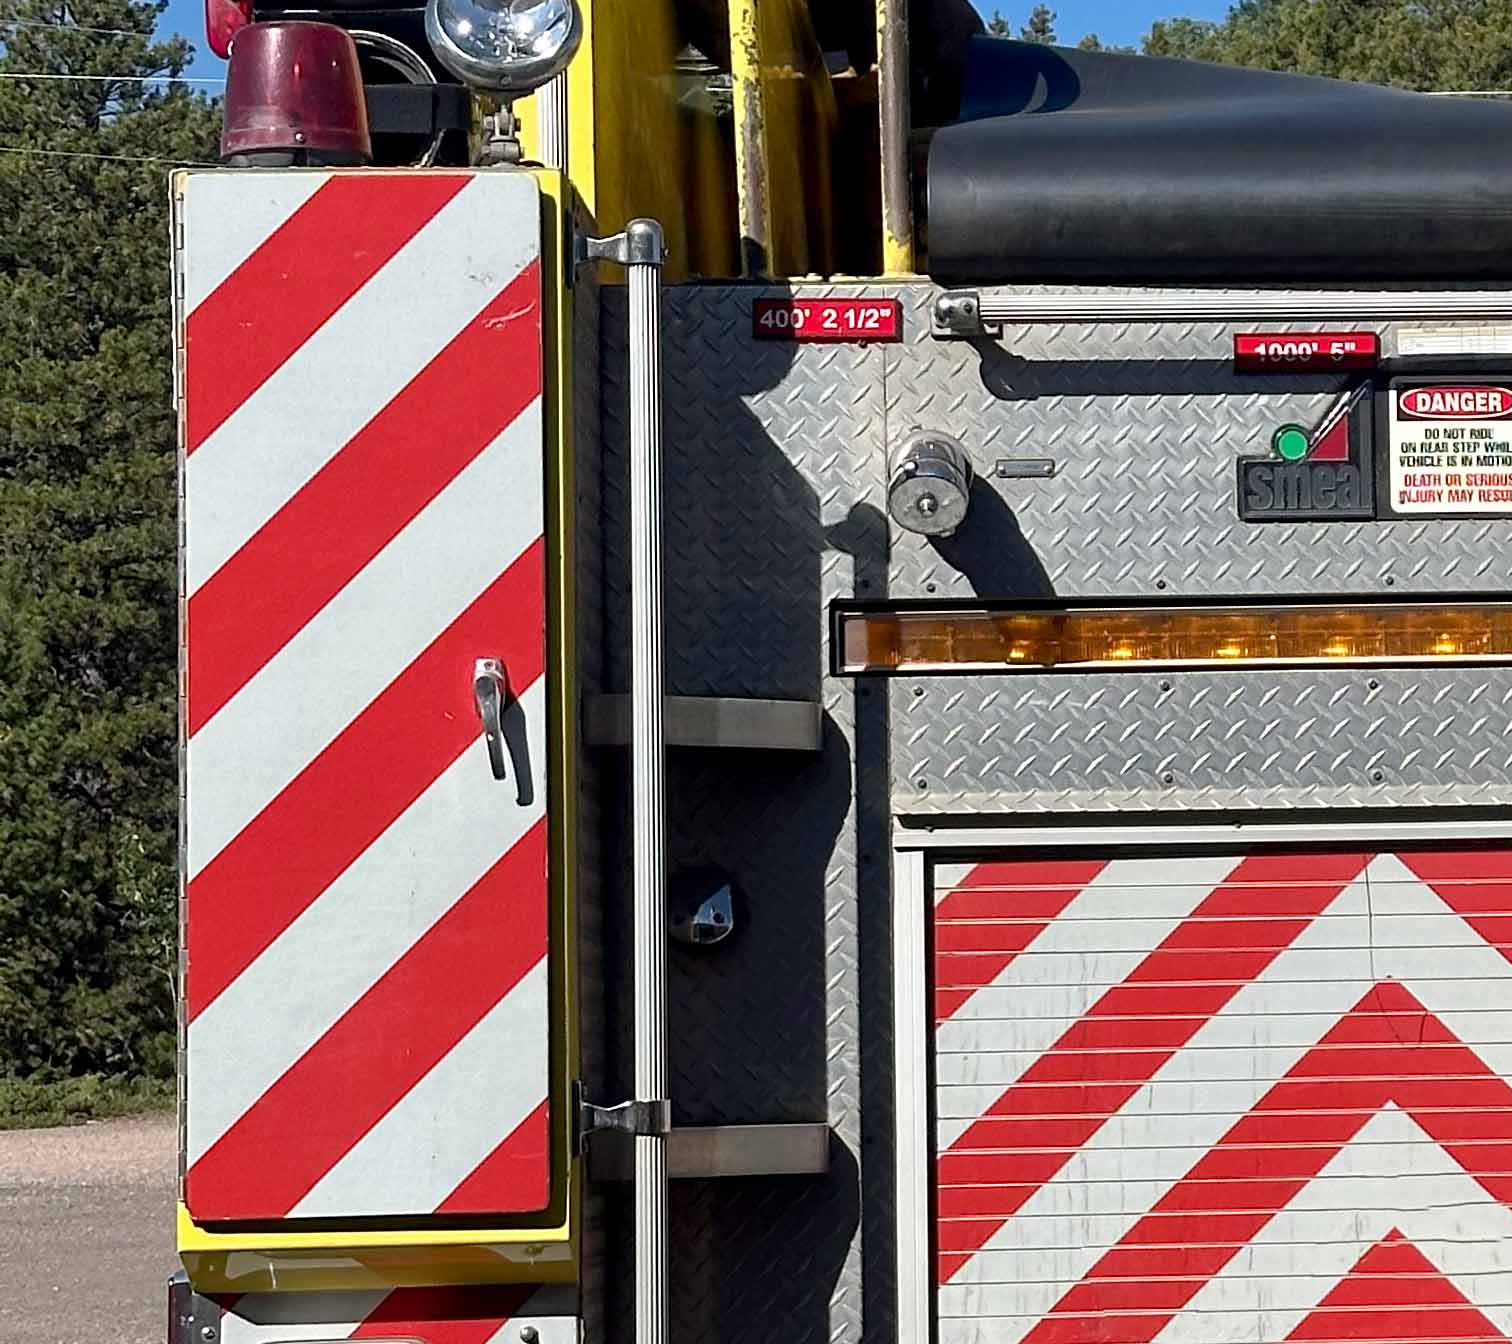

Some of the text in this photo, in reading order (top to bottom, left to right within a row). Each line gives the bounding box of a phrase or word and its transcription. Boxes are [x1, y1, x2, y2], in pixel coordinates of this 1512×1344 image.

[760, 308, 892, 329] 400' 2 1/2"
[1254, 342, 1356, 362] 1000' 5"
[1416, 391, 1503, 413] DANGER
[1424, 428, 1495, 440] DO NOT RIDE
[1400, 441, 1417, 453] ON
[1420, 441, 1449, 453] REAR
[1452, 441, 1480, 453] STEP
[1399, 455, 1443, 467] VEHICLE
[1447, 455, 1458, 467] IS
[1461, 455, 1473, 467] IN
[1404, 474, 1441, 487] DEATH
[1445, 474, 1462, 487] OR
[1399, 490, 1444, 504] INJURY
[1447, 489, 1474, 503] MAY
